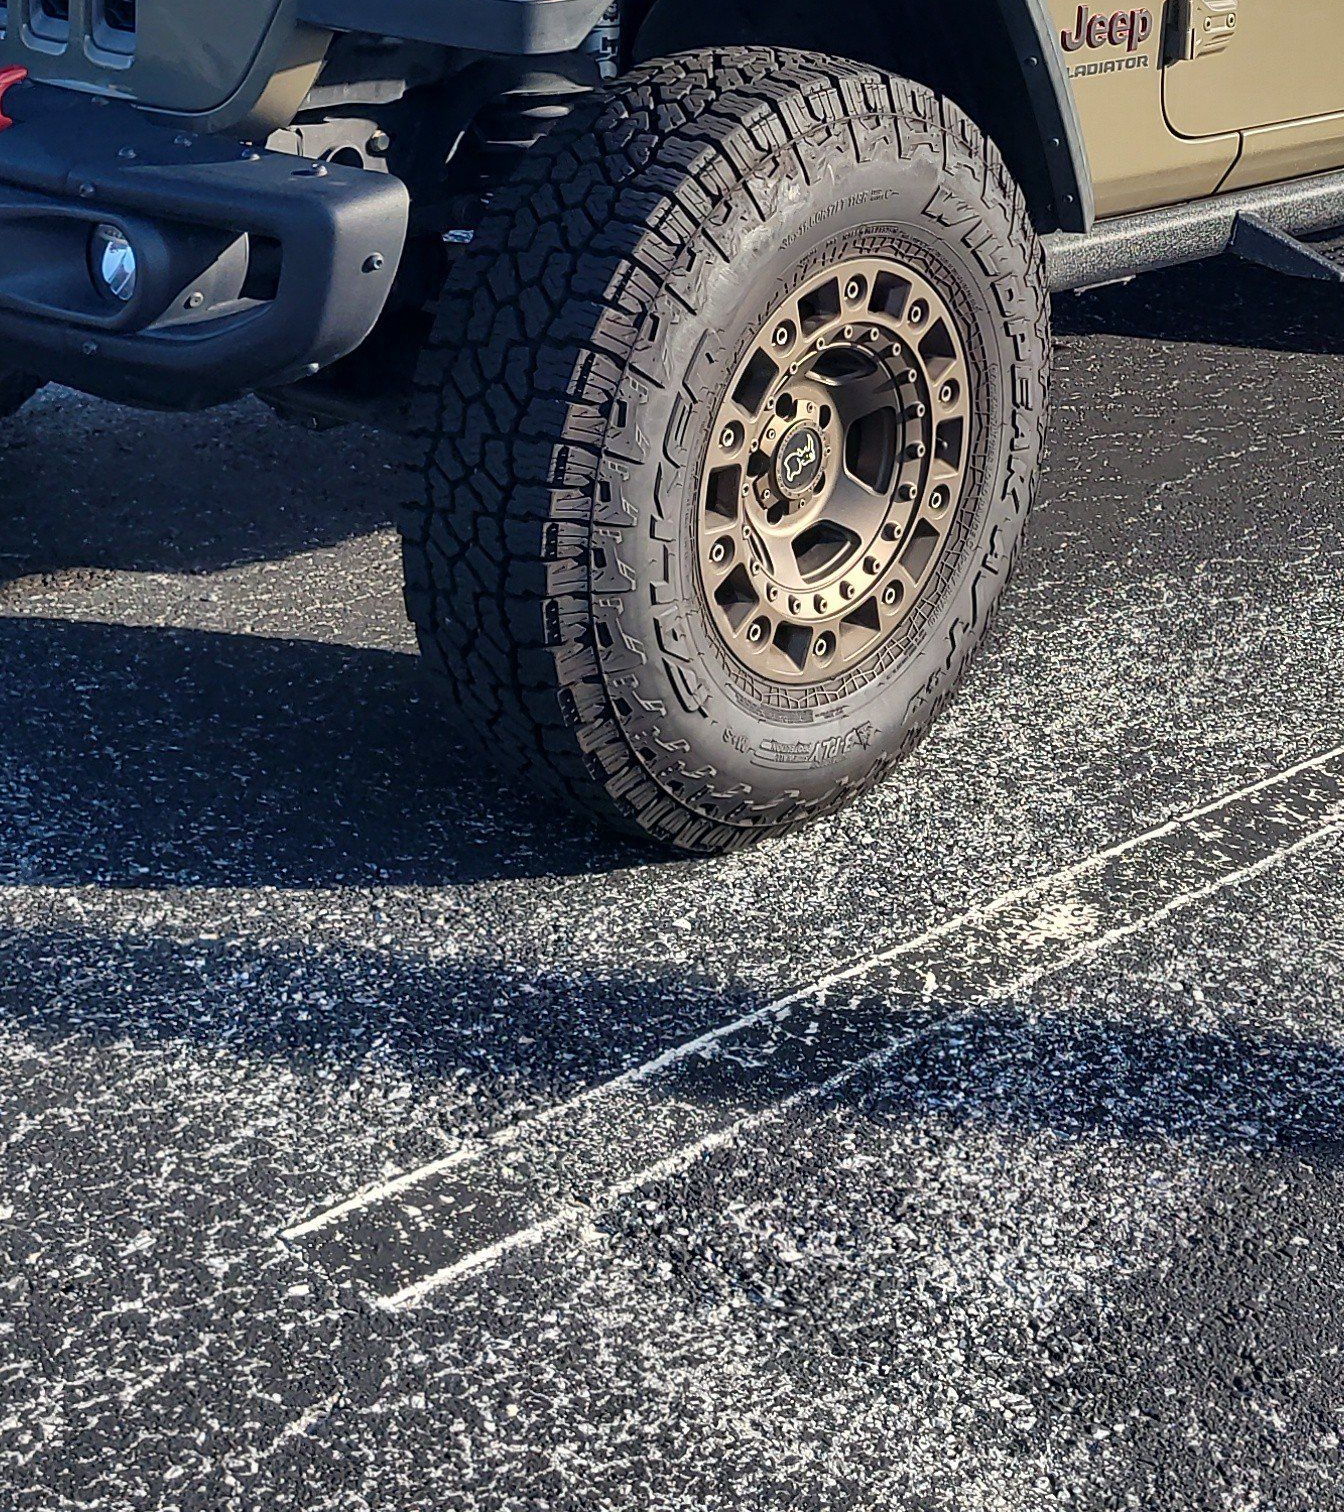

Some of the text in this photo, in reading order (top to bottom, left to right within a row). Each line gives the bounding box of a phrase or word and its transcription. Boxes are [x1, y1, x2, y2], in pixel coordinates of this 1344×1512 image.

[1060, 3, 1154, 53] Jeep
[1066, 54, 1149, 79] LADIATOR
[921, 183, 1035, 515] WILDPEAK
[648, 326, 725, 720] FALKEN
